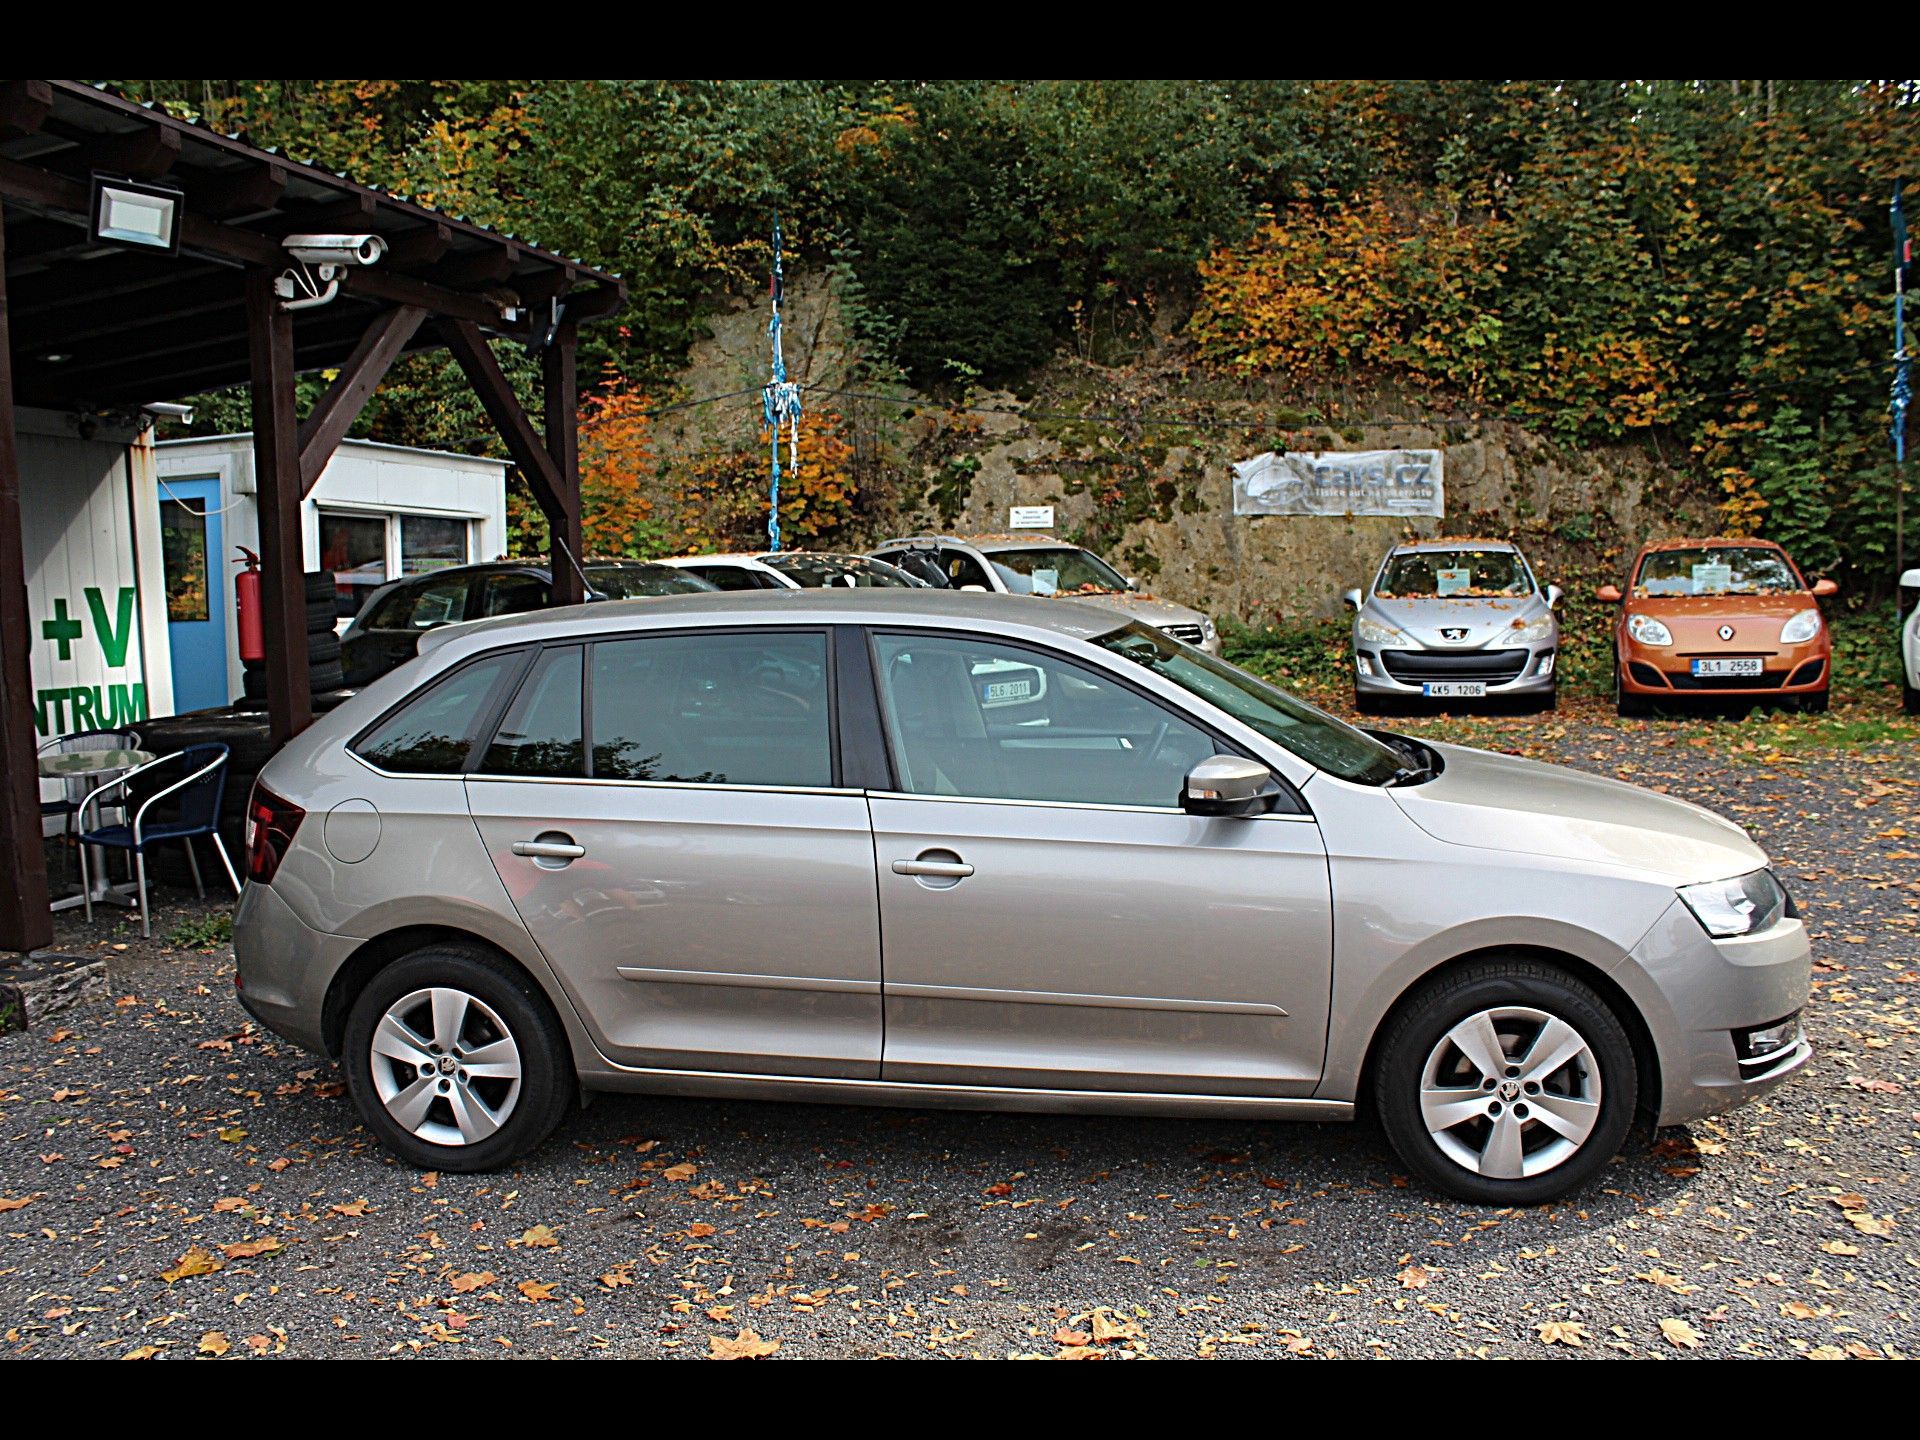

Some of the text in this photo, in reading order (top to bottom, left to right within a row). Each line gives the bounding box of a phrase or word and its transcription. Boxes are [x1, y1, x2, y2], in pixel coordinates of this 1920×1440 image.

[1701, 660, 1758, 672] 3L1 2558
[990, 682, 1027, 697] 5L6 2011
[1431, 685, 1481, 695] 4K5 1206
